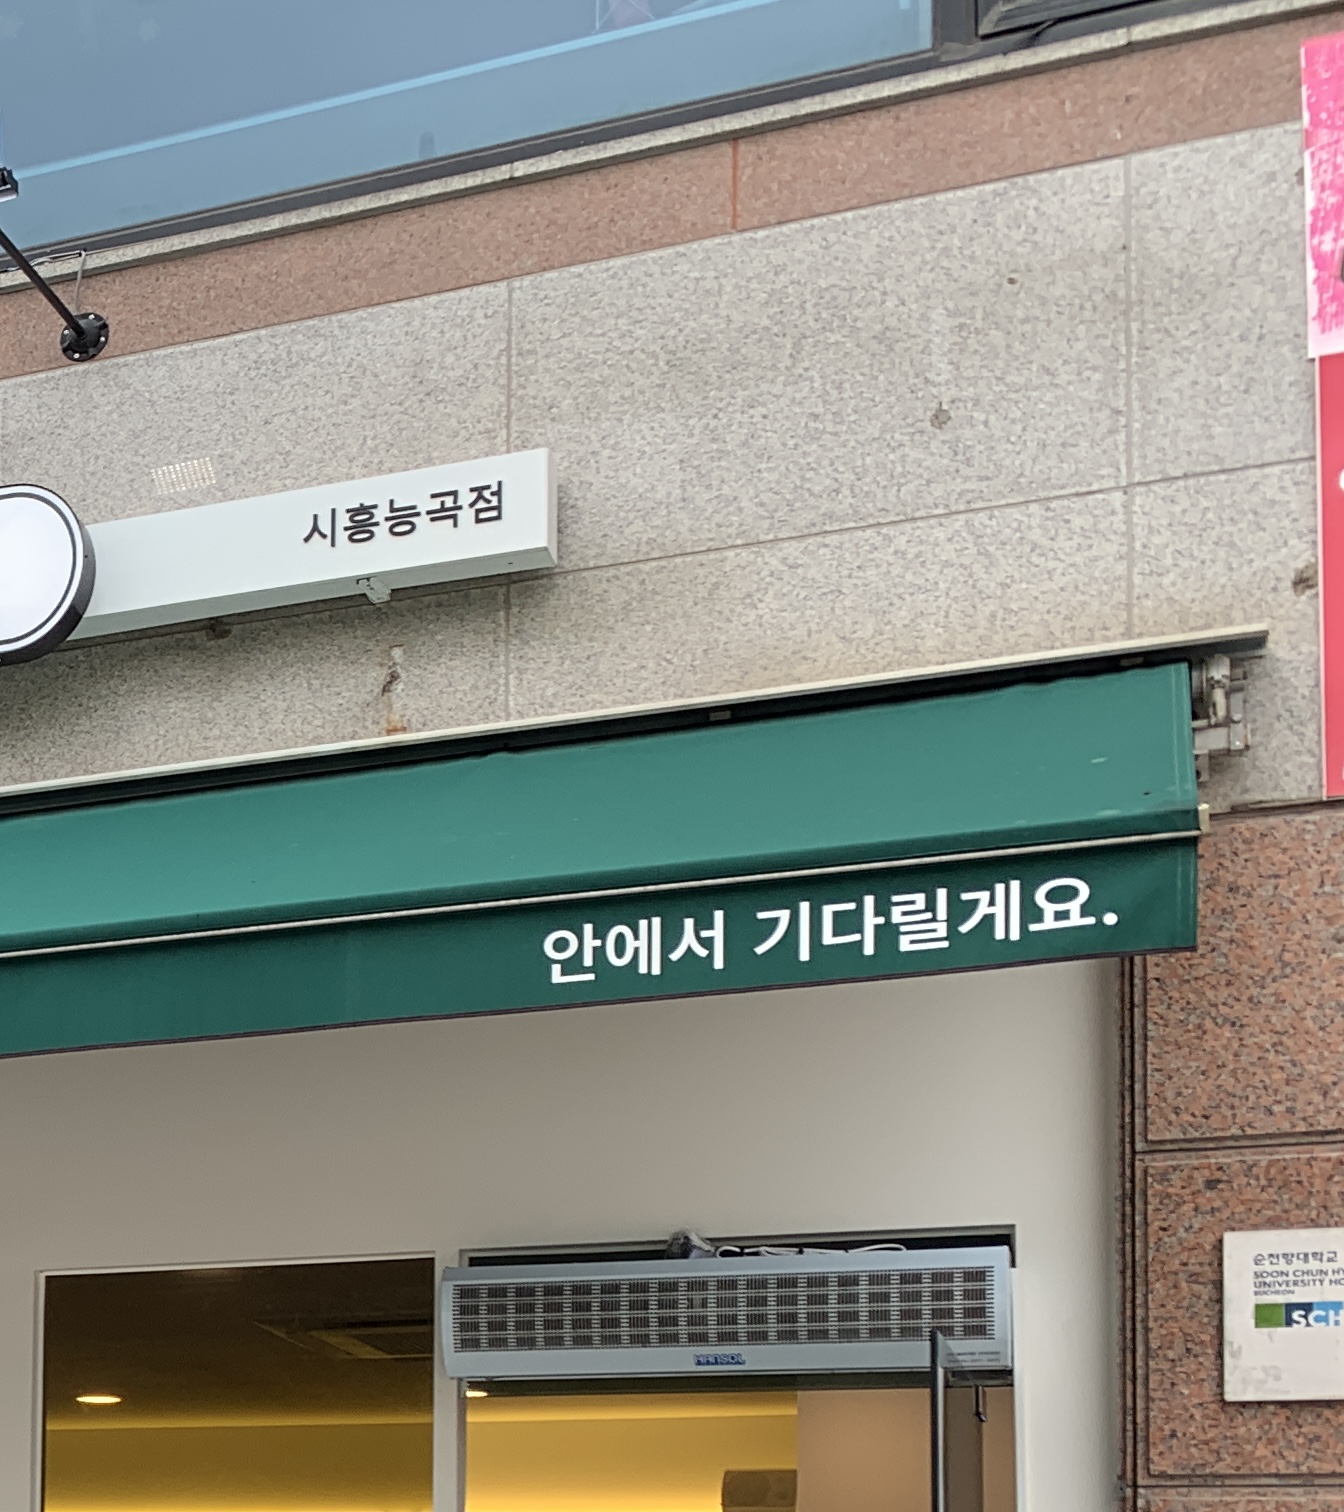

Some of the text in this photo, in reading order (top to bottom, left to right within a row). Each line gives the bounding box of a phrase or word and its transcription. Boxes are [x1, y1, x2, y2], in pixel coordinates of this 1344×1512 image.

[301, 480, 507, 552] 시흥능곡점
[542, 876, 1119, 985] 안에서 기다릴게요.
[1253, 1250, 1338, 1266] 순천향대학교
[1253, 1270, 1289, 1279] SOON
[1292, 1268, 1329, 1278] CHUN
[1253, 1278, 1326, 1289] UNIVERSITY
